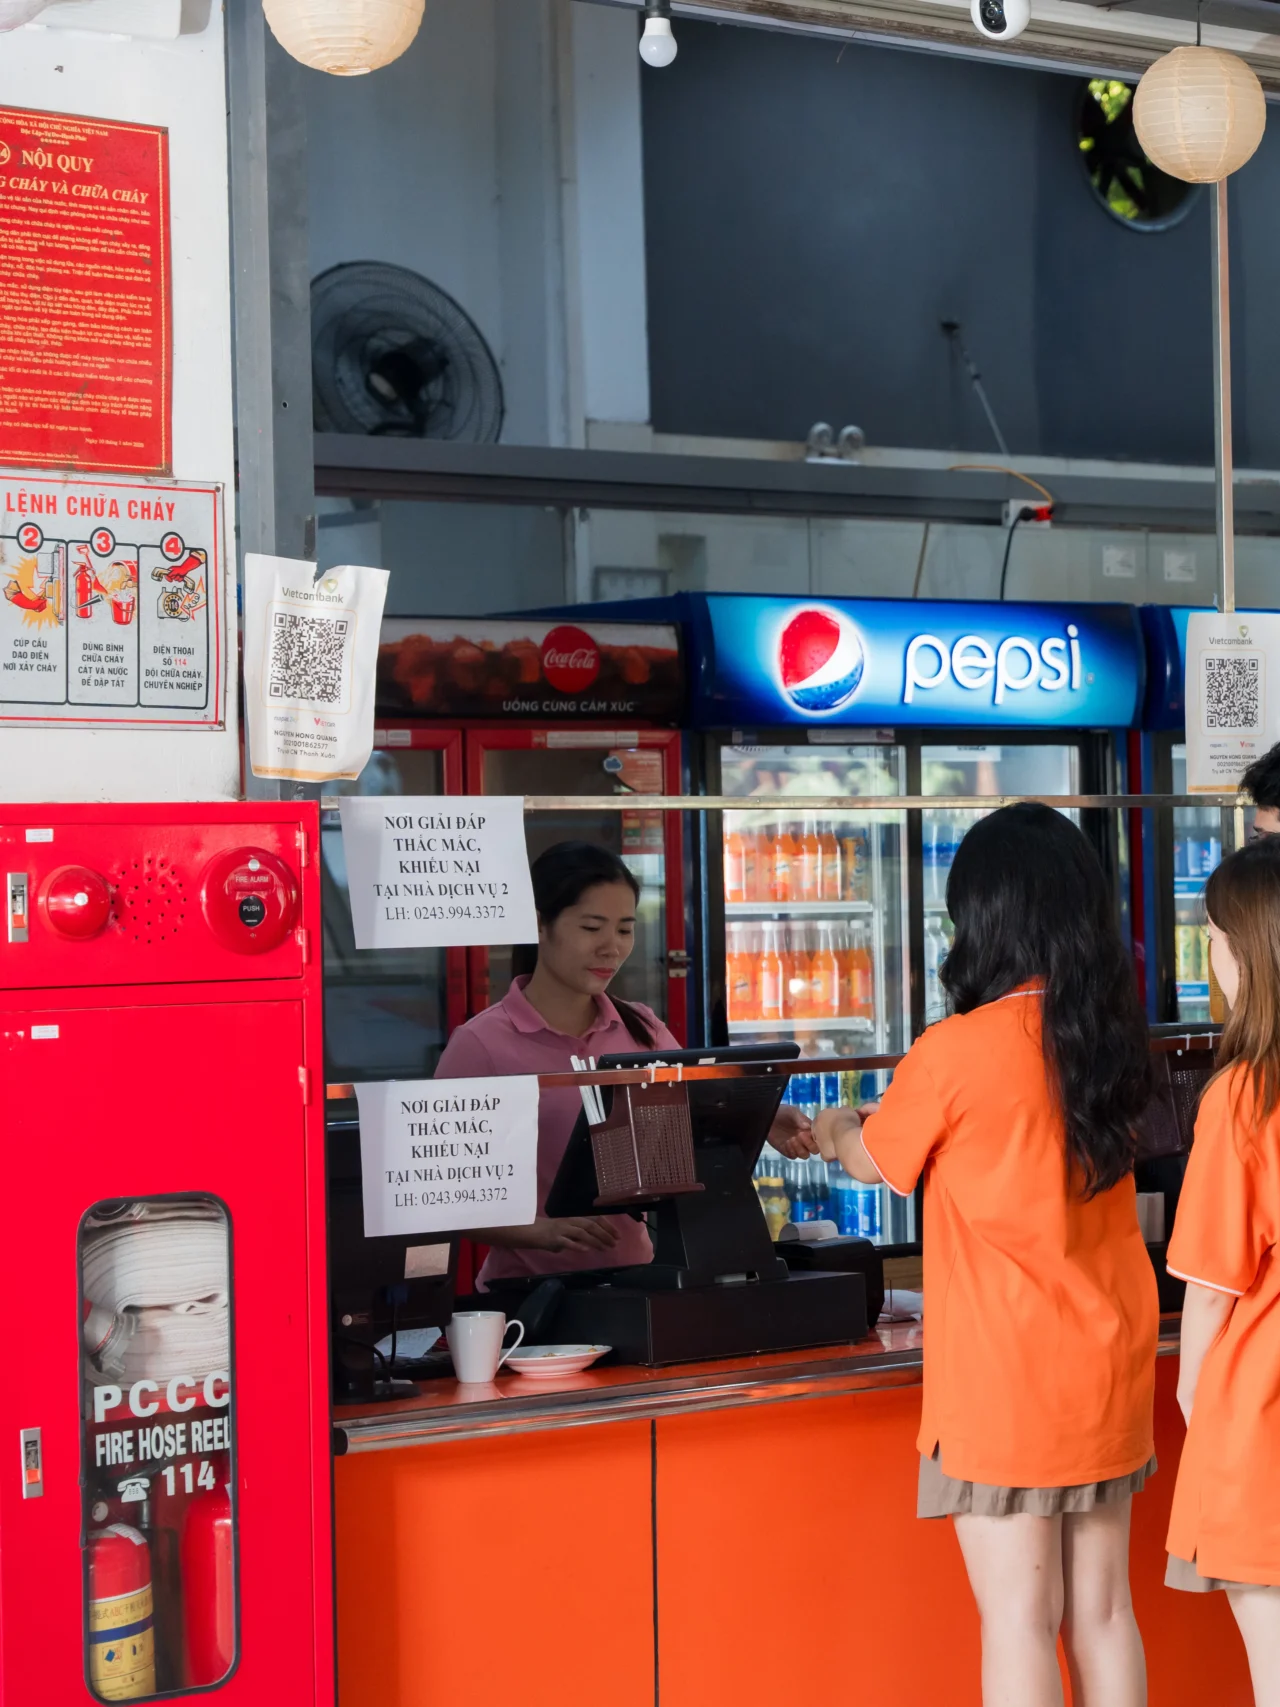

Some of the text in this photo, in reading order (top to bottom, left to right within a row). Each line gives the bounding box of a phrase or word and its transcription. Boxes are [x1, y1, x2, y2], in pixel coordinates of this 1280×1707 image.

[22, 147, 94, 174] NỘI QUY
[9, 176, 49, 192] CHÁY
[51, 180, 69, 195] VÀ
[72, 184, 109, 199] CHỮA
[112, 188, 149, 204] CHÁY
[6, 488, 176, 522] LỆNH CHỮA CHÁY
[22, 527, 39, 547] 2
[96, 532, 111, 552] 3
[164, 536, 181, 556] 4
[282, 586, 344, 604] Vietcombank
[13, 637, 30, 647] CÚP
[153, 644, 195, 656] ĐIỆN THOẠI
[1209, 636, 1253, 646] Vietcombank
[12, 651, 28, 659] DAO
[81, 653, 125, 663] CHỮA CHÁY
[162, 655, 187, 666] SỐ 114
[903, 624, 1082, 705] pepsi
[3, 661, 16, 671] NƠI
[36, 663, 57, 672] CHÁY
[107, 666, 128, 676] NƯỚC
[160, 668, 180, 678] CHỮA
[182, 669, 202, 679] CHÁY
[144, 679, 203, 691] CHUYÊN NGHIỆP
[502, 696, 539, 712] UỐNG
[295, 732, 315, 740] HONG
[316, 734, 338, 742] QUANG
[384, 812, 486, 830] NƠI GIẢI ĐÁP
[393, 833, 481, 854] THẮC MẮC,
[399, 856, 480, 876] KHIẾU NẠI
[235, 875, 269, 883] FIRE ALARM
[373, 880, 509, 899] TẠI NHÀ DỊCH VỤ 2
[385, 905, 506, 920] LH: 0243.994.3372
[401, 1094, 501, 1115] NƠI GIẢI ĐÁP
[407, 1116, 493, 1137] THẮC MẮC,
[411, 1140, 490, 1159] KHIẾU NẠI
[385, 1164, 514, 1186] TẠI NHÀ DỊCH VỤ 2
[394, 1187, 508, 1207] LH: 0243.994.3372
[94, 1370, 230, 1423] PCCC
[95, 1430, 134, 1467] FIRE
[138, 1423, 187, 1461] HOSE
[162, 1461, 215, 1496] 114
